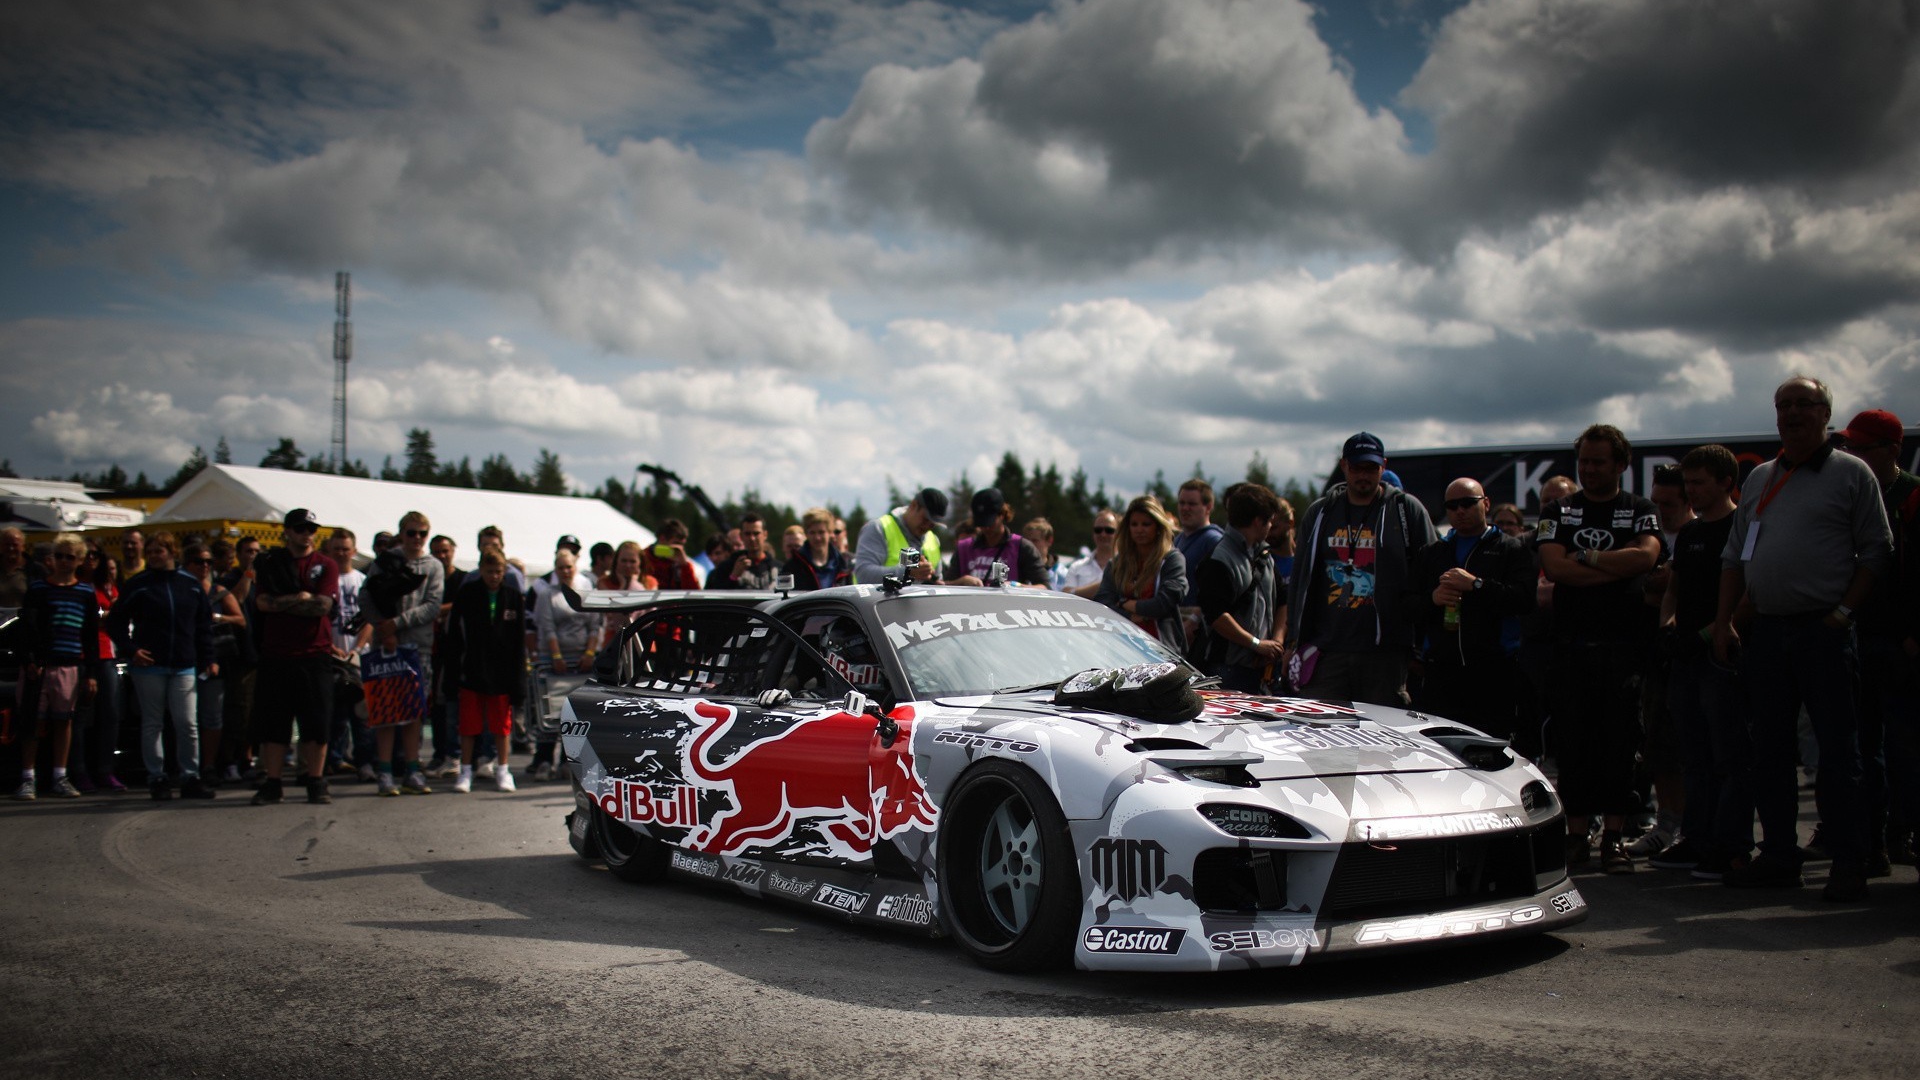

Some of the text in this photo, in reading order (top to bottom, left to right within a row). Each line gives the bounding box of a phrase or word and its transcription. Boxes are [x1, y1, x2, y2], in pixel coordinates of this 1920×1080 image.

[884, 613, 1019, 649] METAL
[934, 731, 1041, 755] NITTO
[628, 783, 698, 828] Bull
[671, 850, 720, 878] Racetech
[722, 860, 767, 886] KTM
[828, 889, 867, 911] TEIN
[888, 893, 932, 925] etnies
[1104, 928, 1171, 951] Castrol
[1209, 928, 1321, 953] SEIBON
